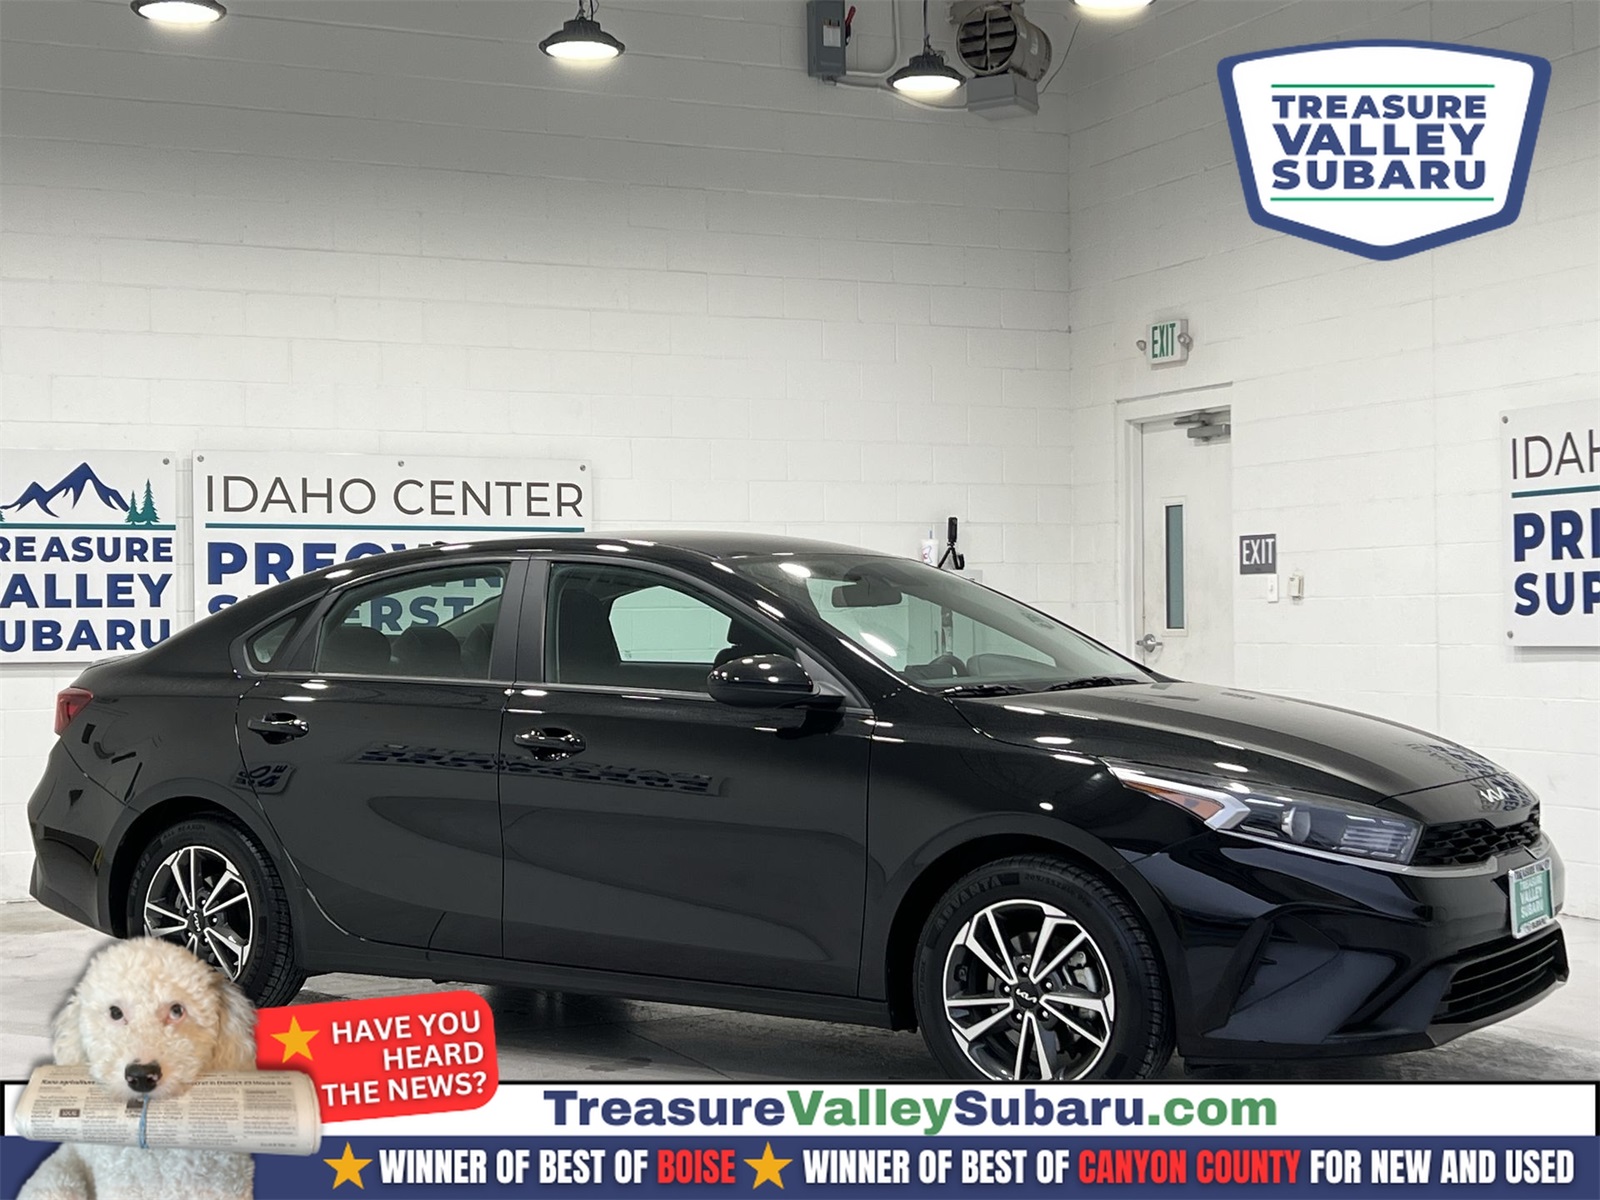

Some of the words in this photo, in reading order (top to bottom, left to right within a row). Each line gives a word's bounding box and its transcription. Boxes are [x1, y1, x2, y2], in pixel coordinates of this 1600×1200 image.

[1151, 322, 1176, 359] EXIT
[207, 475, 376, 514] IDAHO
[394, 479, 584, 517] CENTER
[1242, 538, 1275, 565] EXIT
[0, 573, 173, 608] ALLEY
